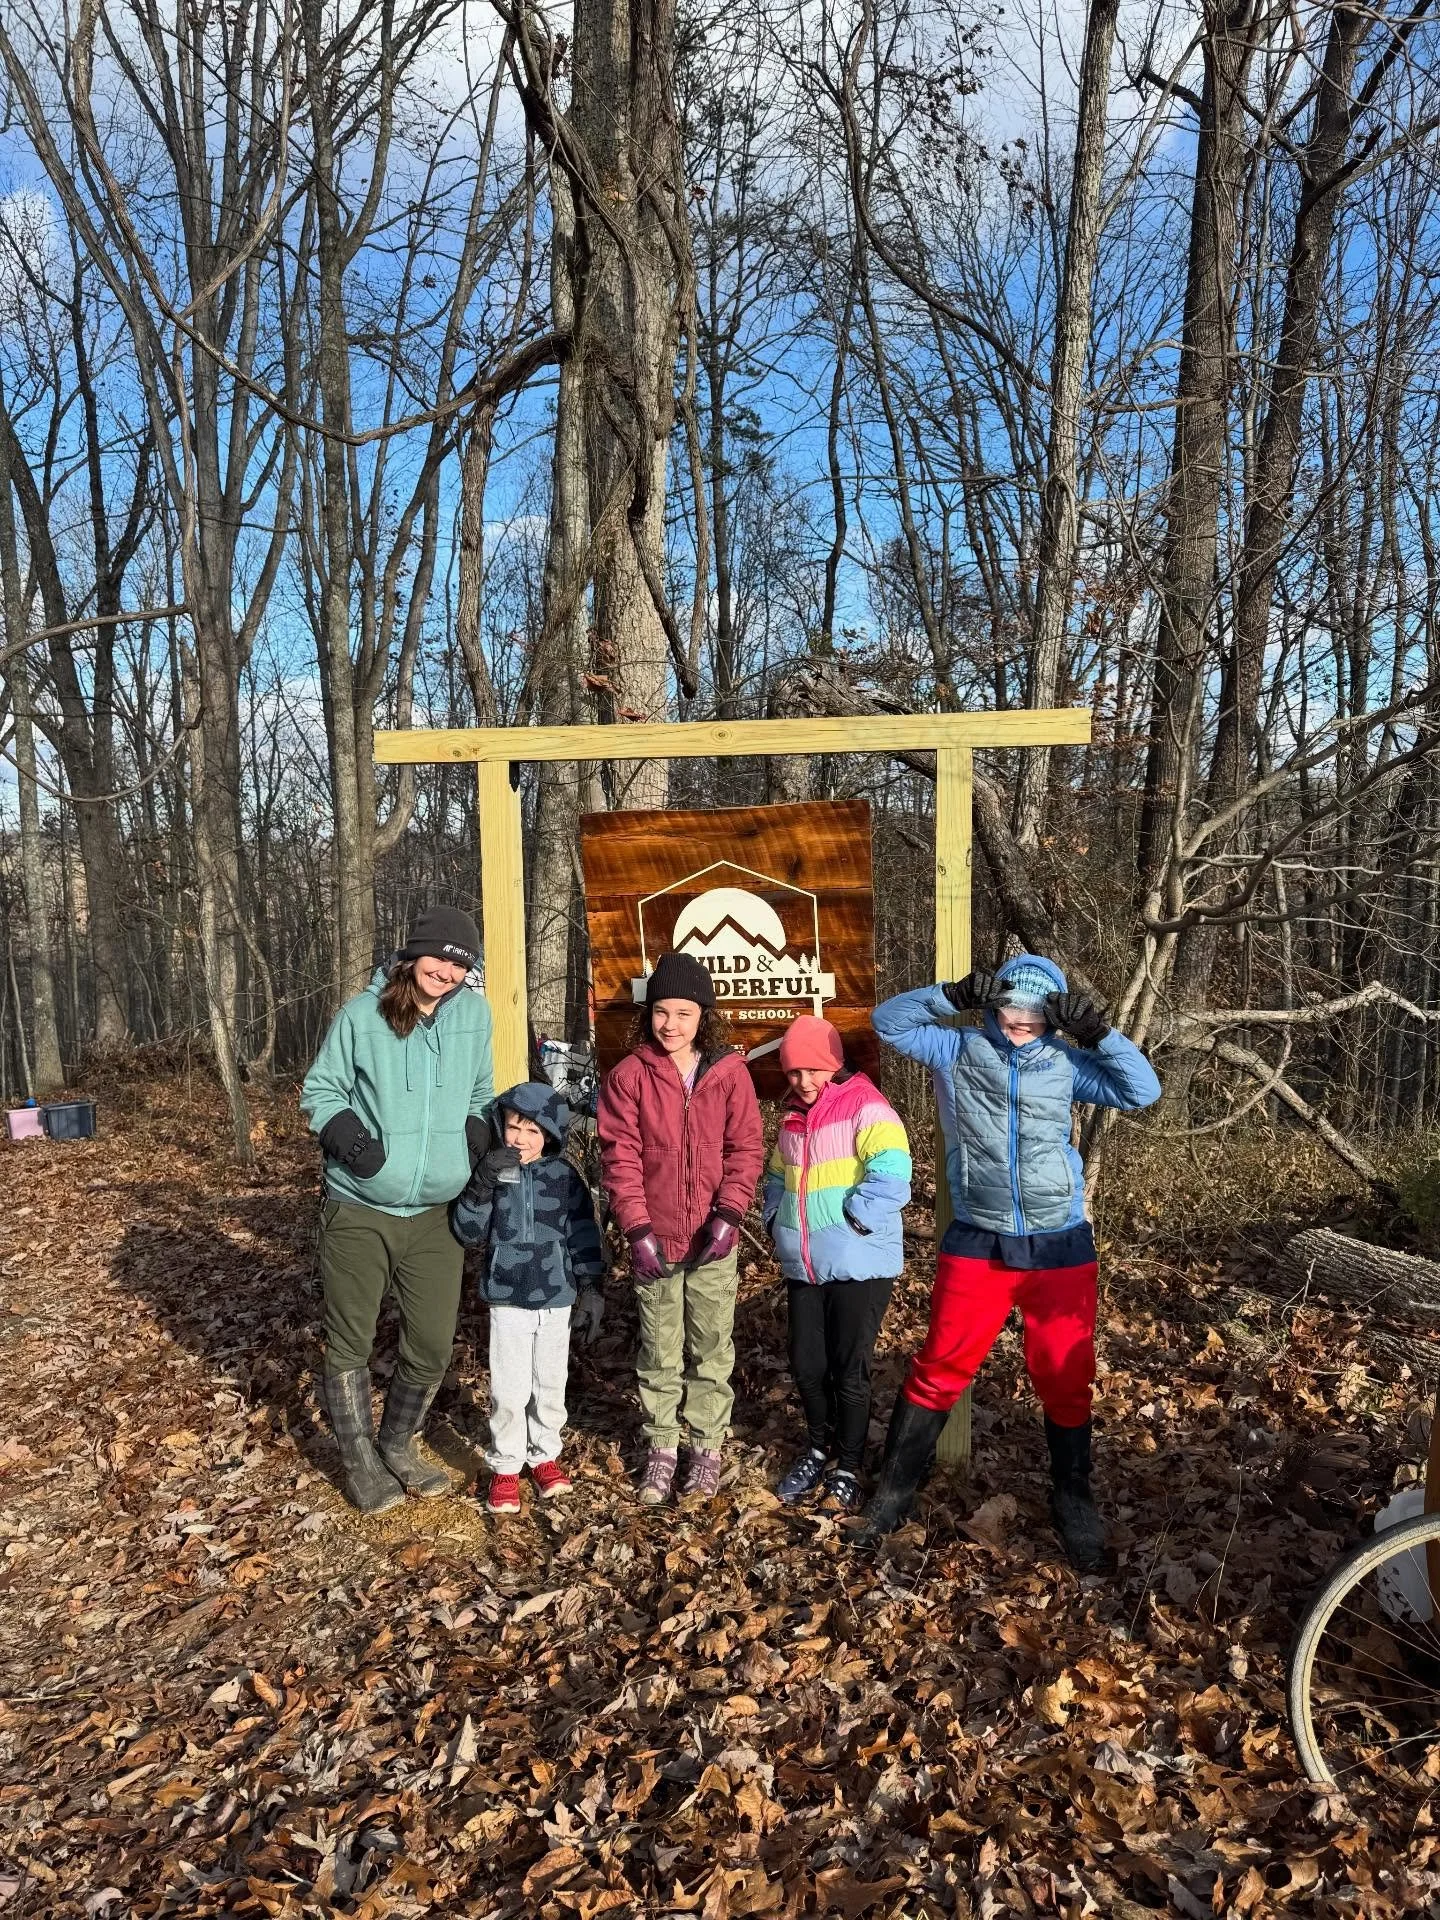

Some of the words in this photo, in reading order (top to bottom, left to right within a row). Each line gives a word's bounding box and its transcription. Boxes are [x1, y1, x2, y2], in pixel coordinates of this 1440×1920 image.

[756, 954, 774, 973] &
[713, 977, 820, 997] DERFUL
[738, 1009, 795, 1020] SCHOOL
